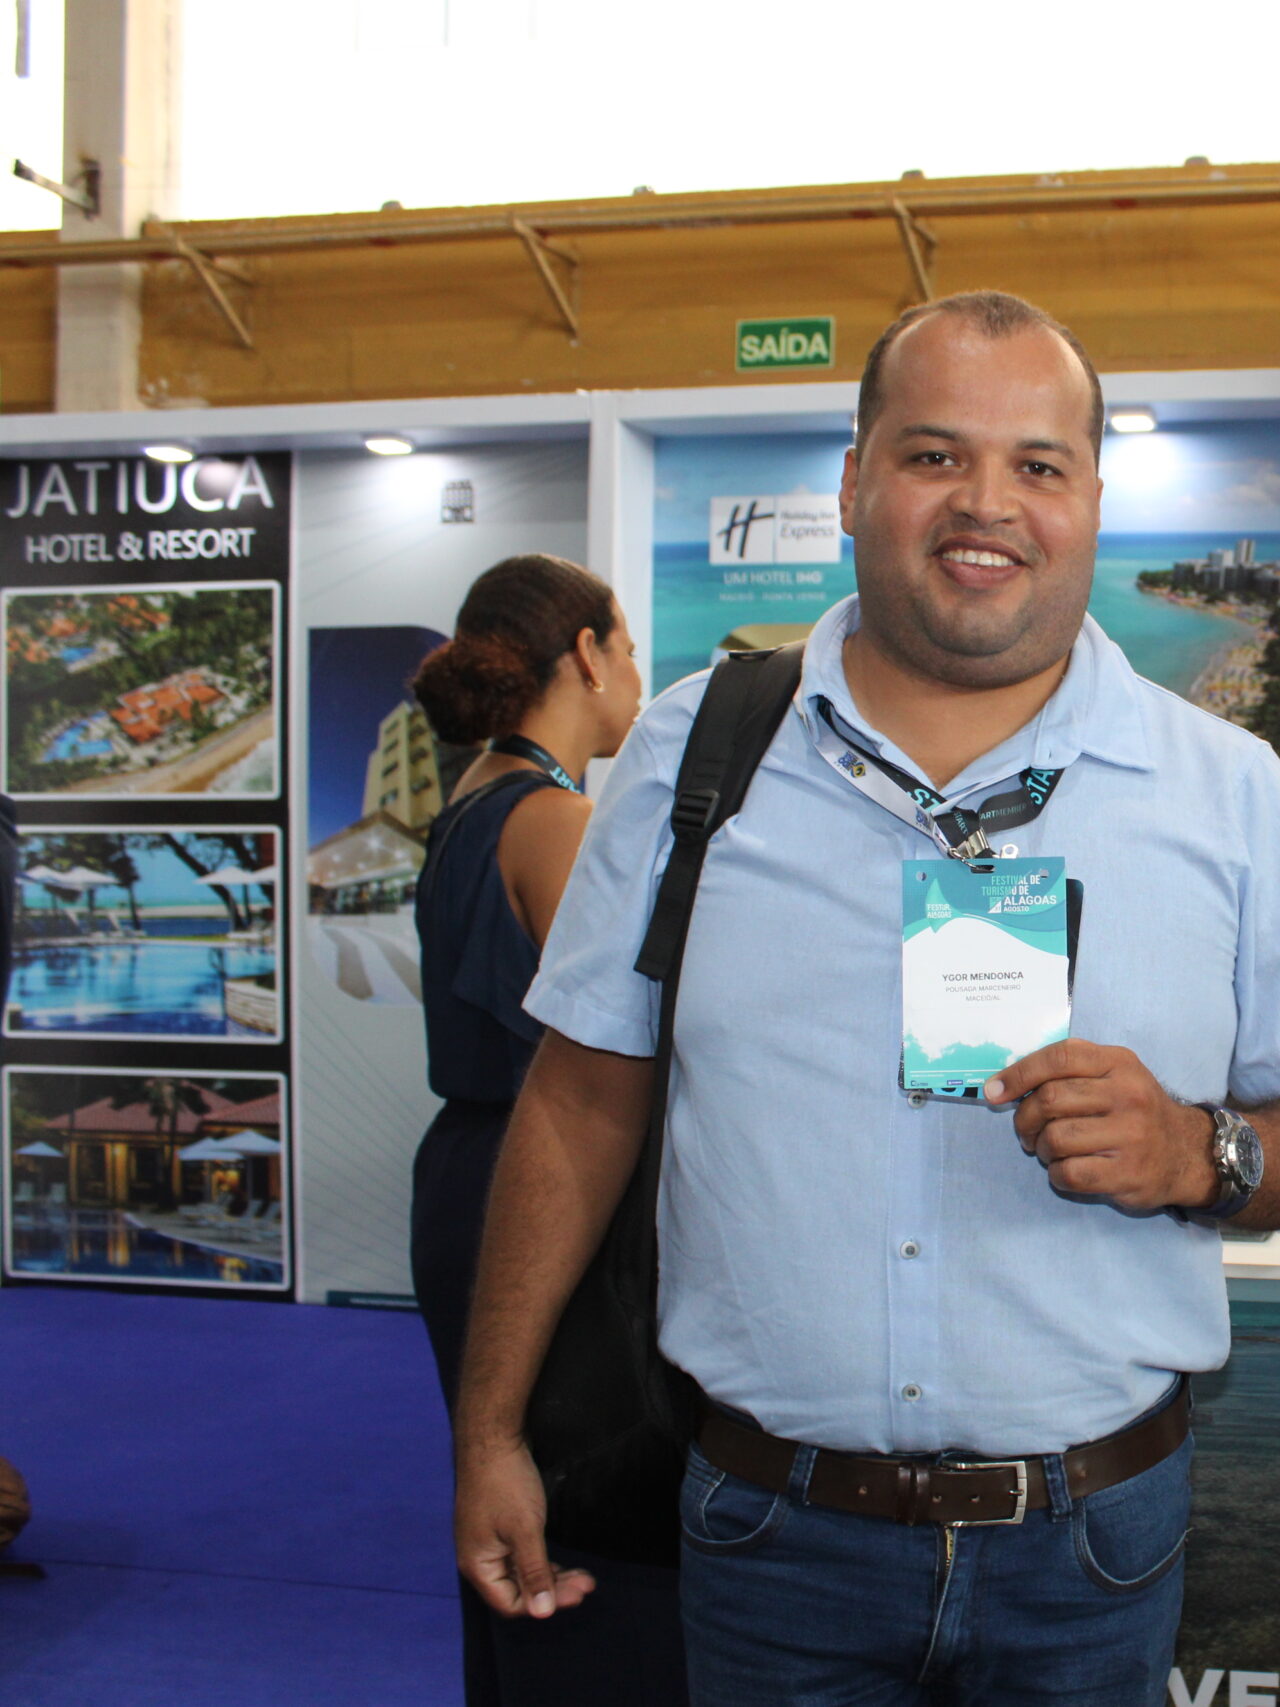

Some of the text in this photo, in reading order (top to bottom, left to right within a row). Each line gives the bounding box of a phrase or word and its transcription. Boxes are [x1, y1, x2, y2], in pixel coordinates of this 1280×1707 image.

[741, 327, 829, 362] SAÍDA
[7, 455, 274, 518] JATIUCA
[781, 523, 835, 540] Express
[26, 528, 257, 563] HOTEL & RESORT
[723, 572, 747, 585] UM
[750, 571, 792, 585] HOTEL
[991, 874, 1041, 885] FESTIVAL DE
[982, 885, 1029, 896] TURISMO DE
[1003, 895, 1057, 906] ALAGOAS
[942, 971, 1024, 982] YGOR MENDONÇA
